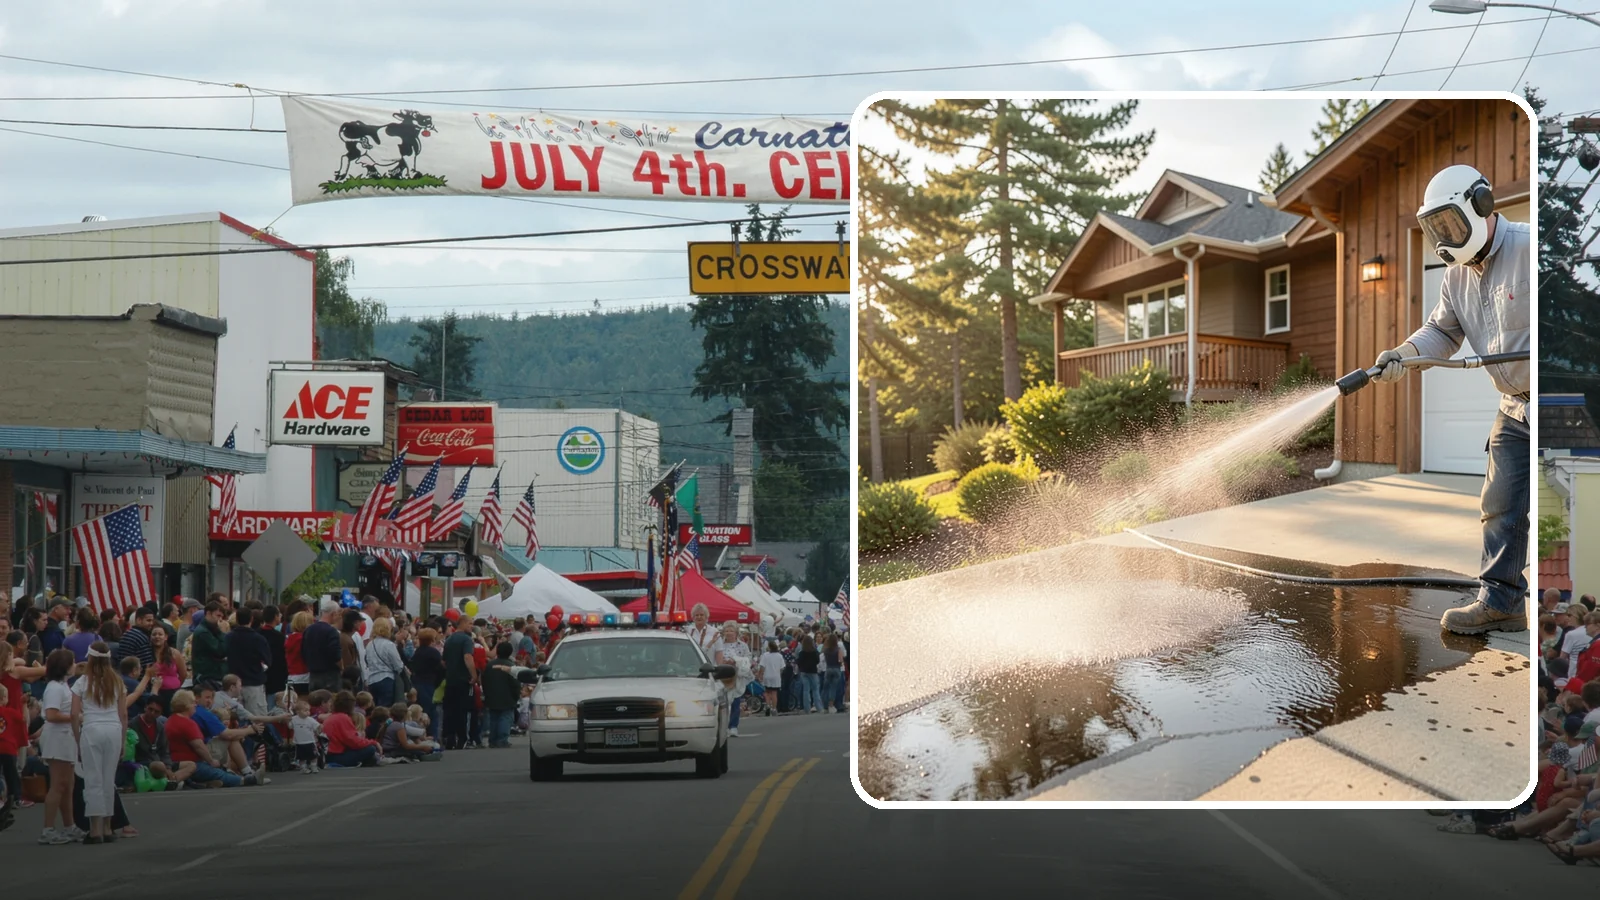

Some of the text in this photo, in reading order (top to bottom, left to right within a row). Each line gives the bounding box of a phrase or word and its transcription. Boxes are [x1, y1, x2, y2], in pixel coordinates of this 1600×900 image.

[695, 121, 850, 149] Carnat
[481, 141, 604, 192] JULY
[632, 150, 746, 197] 4th.
[697, 254, 850, 280] CROSSWA
[283, 380, 374, 420] ACE
[406, 410, 452, 422] CEDAR
[283, 421, 371, 436] Hardware
[353, 467, 385, 480] Simpl
[95, 484, 124, 495] Vincent
[126, 486, 136, 495] de
[137, 486, 155, 495] Paul
[688, 526, 741, 535] CRNATION
[699, 535, 730, 543] GLASS
